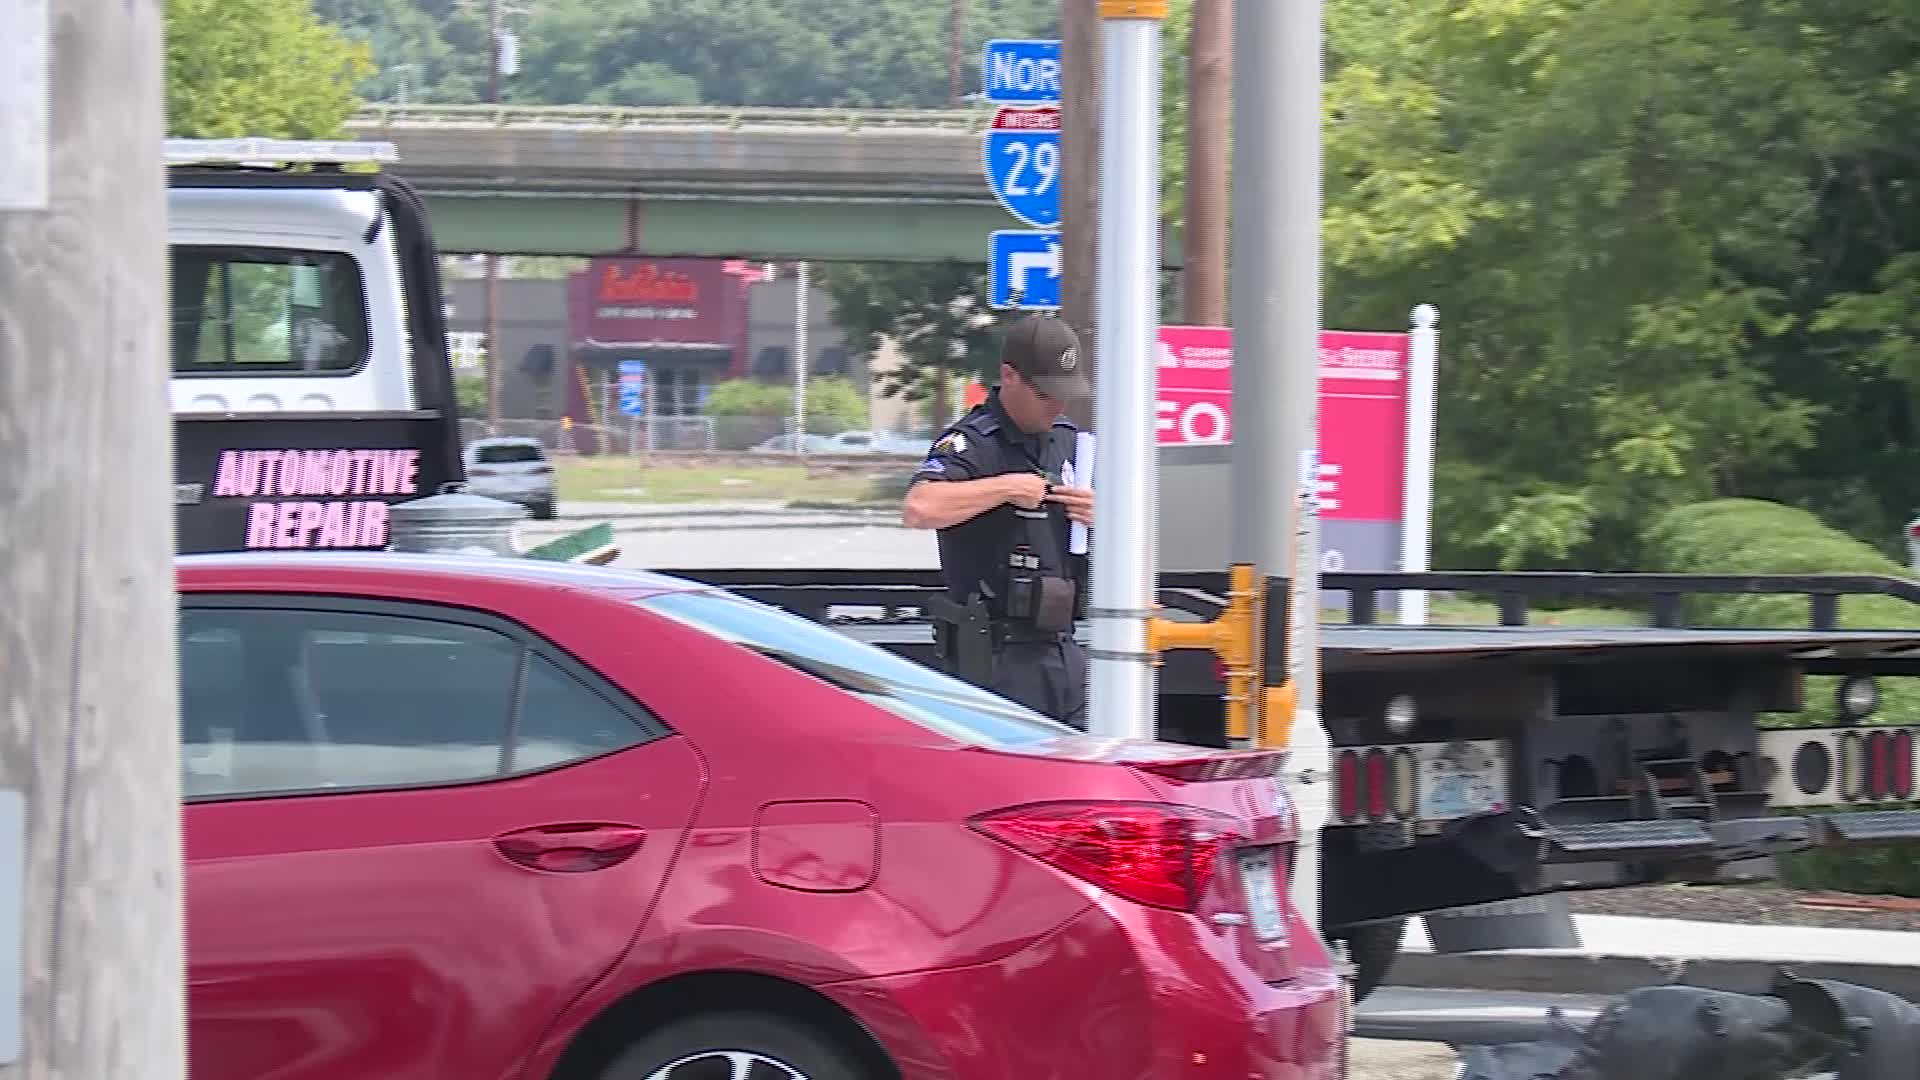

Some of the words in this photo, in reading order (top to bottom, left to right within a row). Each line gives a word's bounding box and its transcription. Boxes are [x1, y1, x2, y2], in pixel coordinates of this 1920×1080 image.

[993, 51, 1061, 91] NOR
[1003, 142, 1060, 196] 29
[212, 448, 422, 497] AUTOMOTIVE
[245, 501, 390, 549] REPAIR
